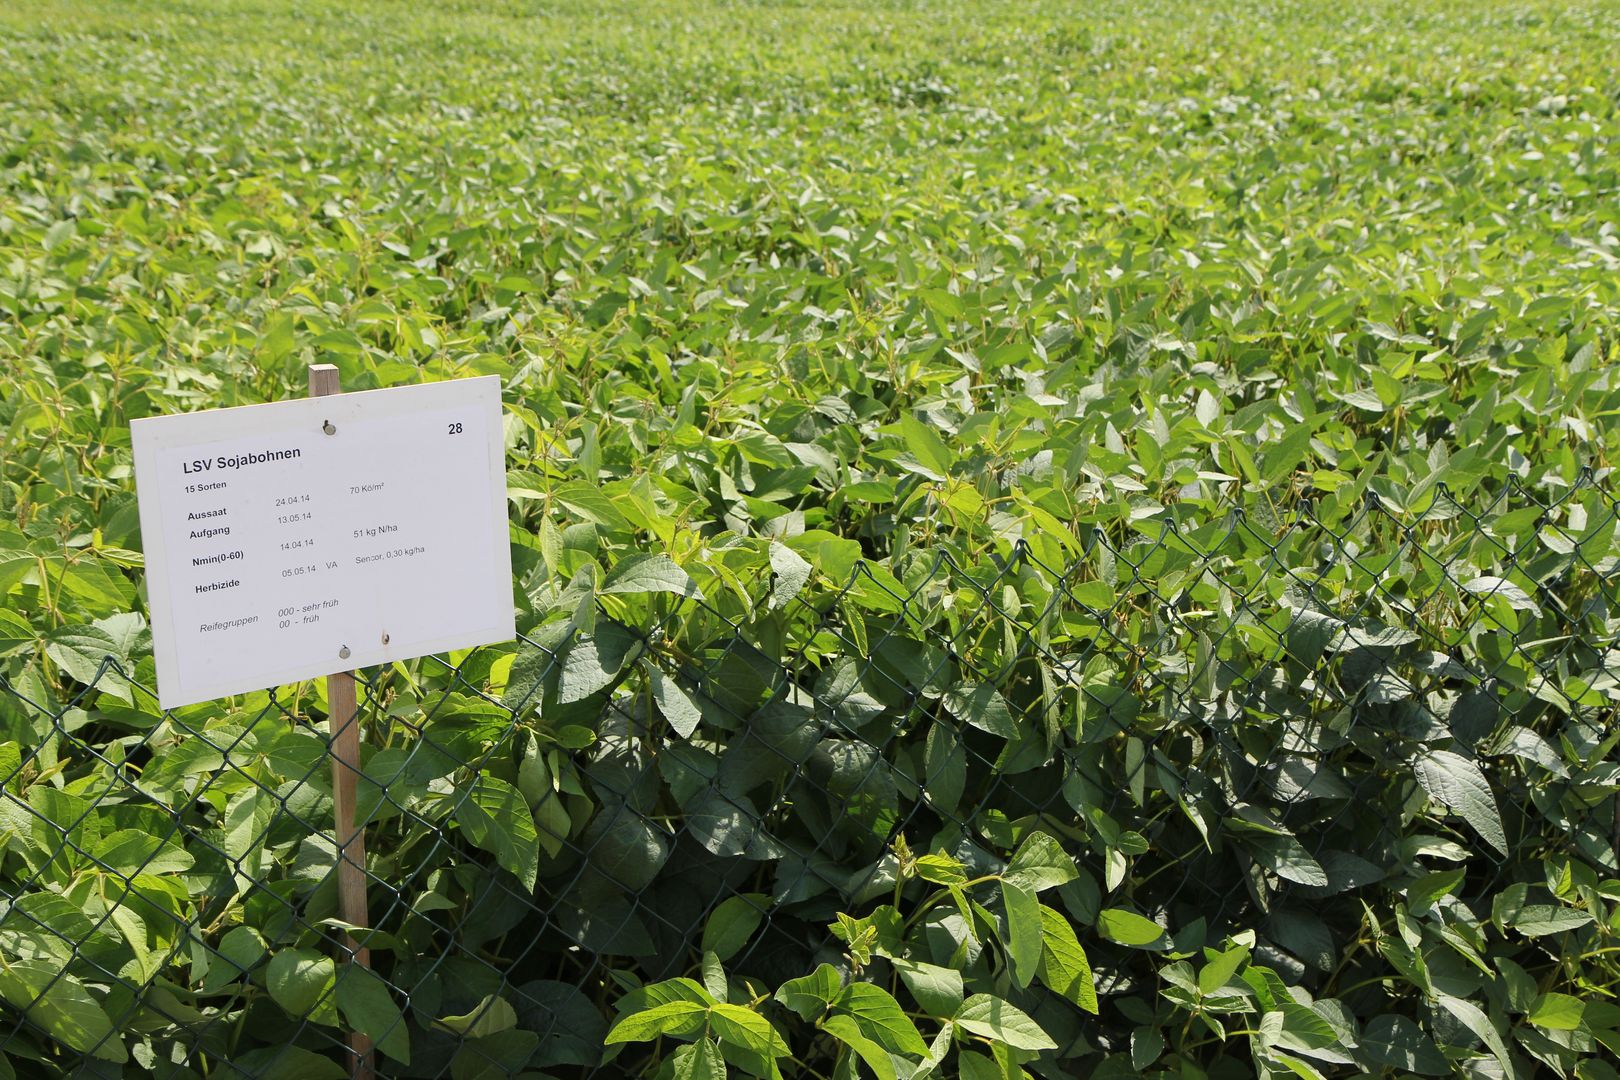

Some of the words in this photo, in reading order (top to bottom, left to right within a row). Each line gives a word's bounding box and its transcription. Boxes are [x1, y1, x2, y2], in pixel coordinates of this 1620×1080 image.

[448, 422, 463, 435] 28
[183, 458, 213, 474] LSV
[217, 448, 301, 469] Sojabohnen
[185, 485, 195, 494] 15
[197, 481, 227, 493] Sorten
[187, 508, 227, 521] Aussaat
[275, 494, 310, 507] 24.04.14
[350, 485, 360, 495] 70
[189, 527, 230, 540] Aufgang
[278, 512, 312, 525] 13.05.14
[193, 550, 244, 566] Nmin(0-60)
[280, 538, 314, 551] 14.04.14
[353, 529, 364, 539] 51
[366, 527, 377, 537] kg
[378, 524, 398, 534] N/ha
[195, 579, 240, 593] Herbizide
[282, 565, 316, 577] 05.05.14
[325, 560, 338, 570] VA
[386, 548, 403, 560] 0,30
[404, 546, 425, 557] kg/ha
[199, 615, 259, 633] Reifegruppen
[278, 606, 295, 618] 000
[302, 603, 322, 613] sehr
[322, 599, 339, 609] früh
[279, 619, 290, 630] 00
[303, 613, 320, 625] früh
